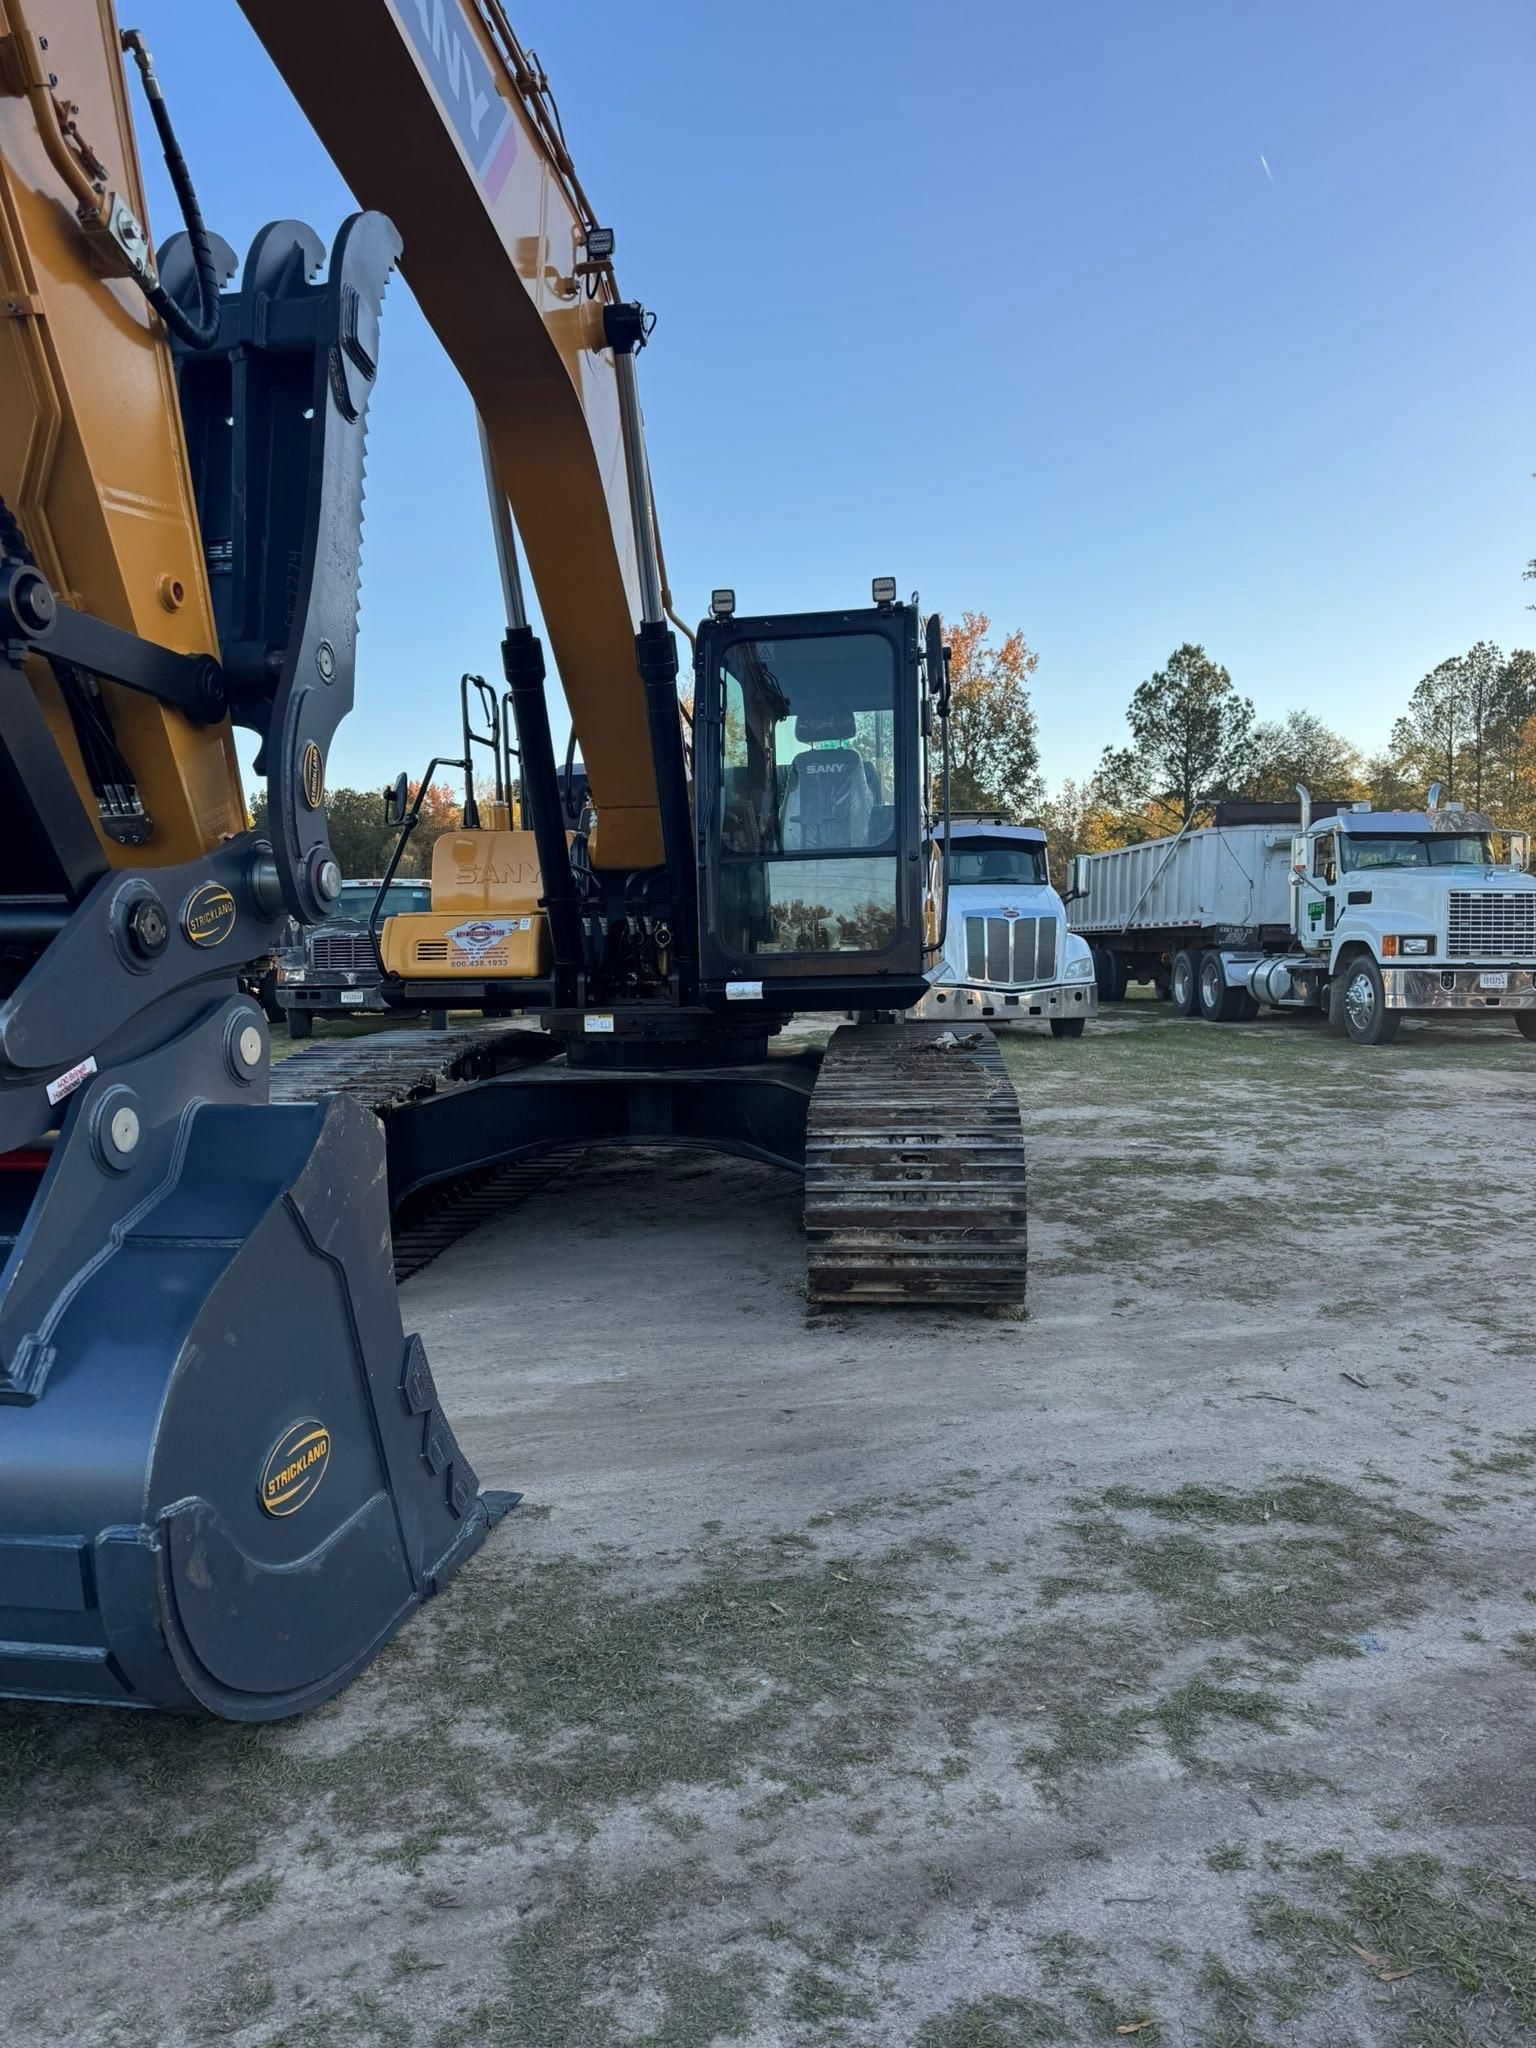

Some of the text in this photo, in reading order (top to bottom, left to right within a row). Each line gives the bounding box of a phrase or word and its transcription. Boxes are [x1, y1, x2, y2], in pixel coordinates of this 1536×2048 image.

[310, 747, 319, 804] STRICKLAND
[805, 763, 844, 775] SANY
[455, 863, 541, 885] SANY
[190, 901, 234, 931] STRICKLAND
[451, 959, 508, 968] 800.438.1933
[57, 1075, 69, 1089] 400
[267, 1439, 327, 1496] STRICKLAND
